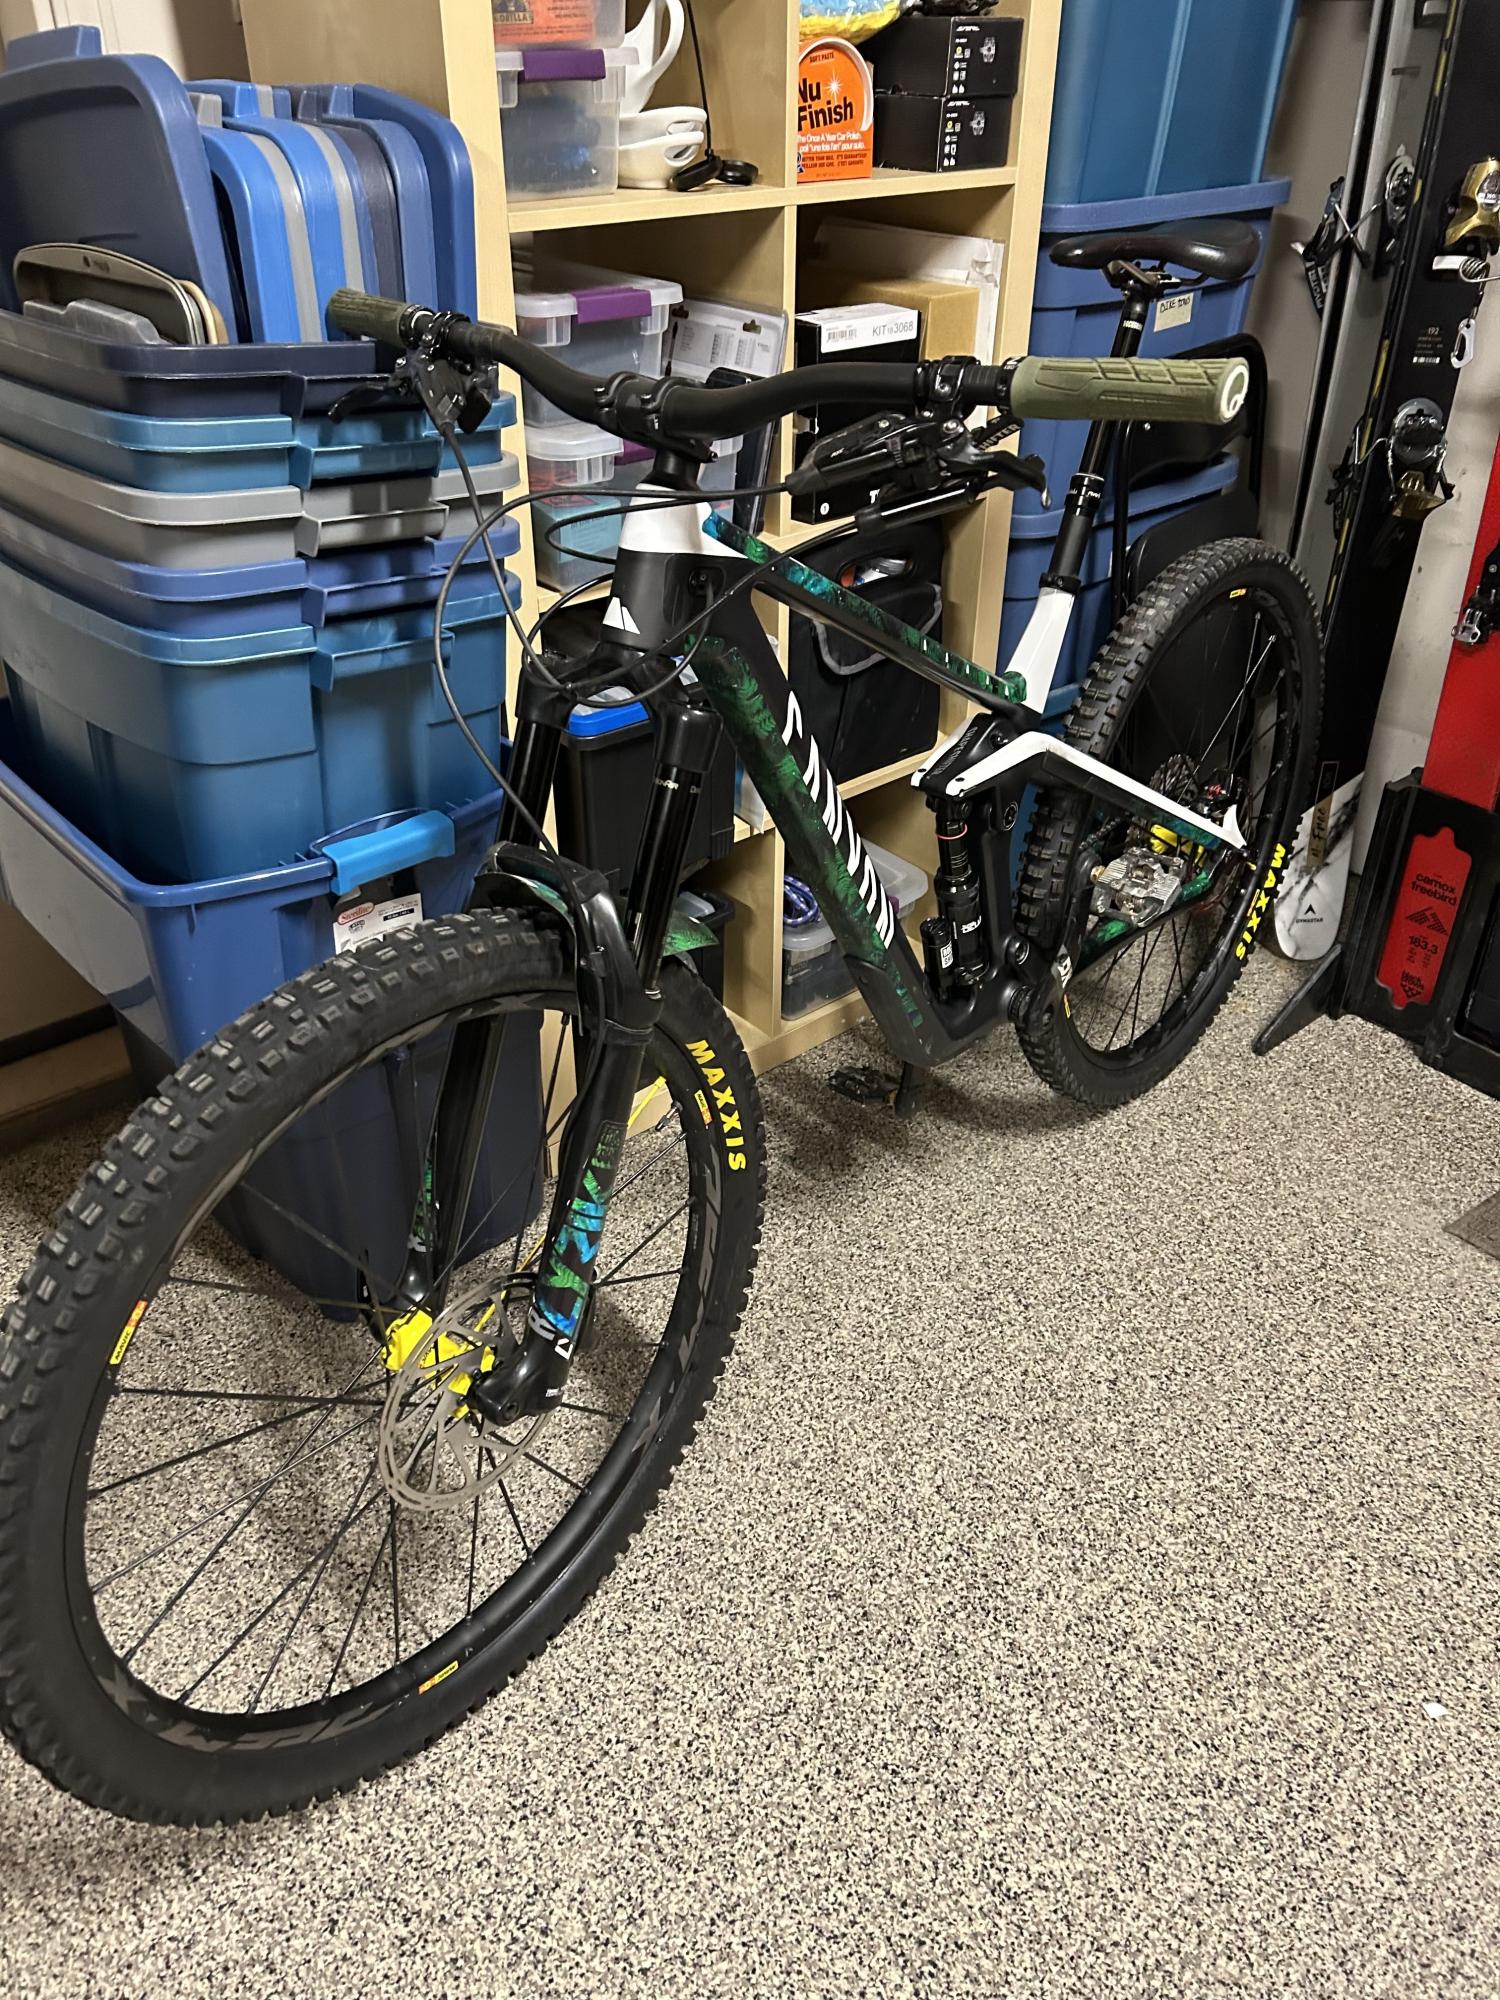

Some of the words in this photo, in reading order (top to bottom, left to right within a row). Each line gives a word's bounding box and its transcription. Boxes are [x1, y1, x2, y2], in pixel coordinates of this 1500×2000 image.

[798, 77, 821, 103] Nu
[798, 96, 853, 132] Finish
[1411, 881, 1458, 906] freebird
[1415, 873, 1457, 894] camox
[1235, 843, 1286, 960] MAXXIS
[1408, 935, 1439, 955] 183.3
[685, 1039, 747, 1171] MAXXIS
